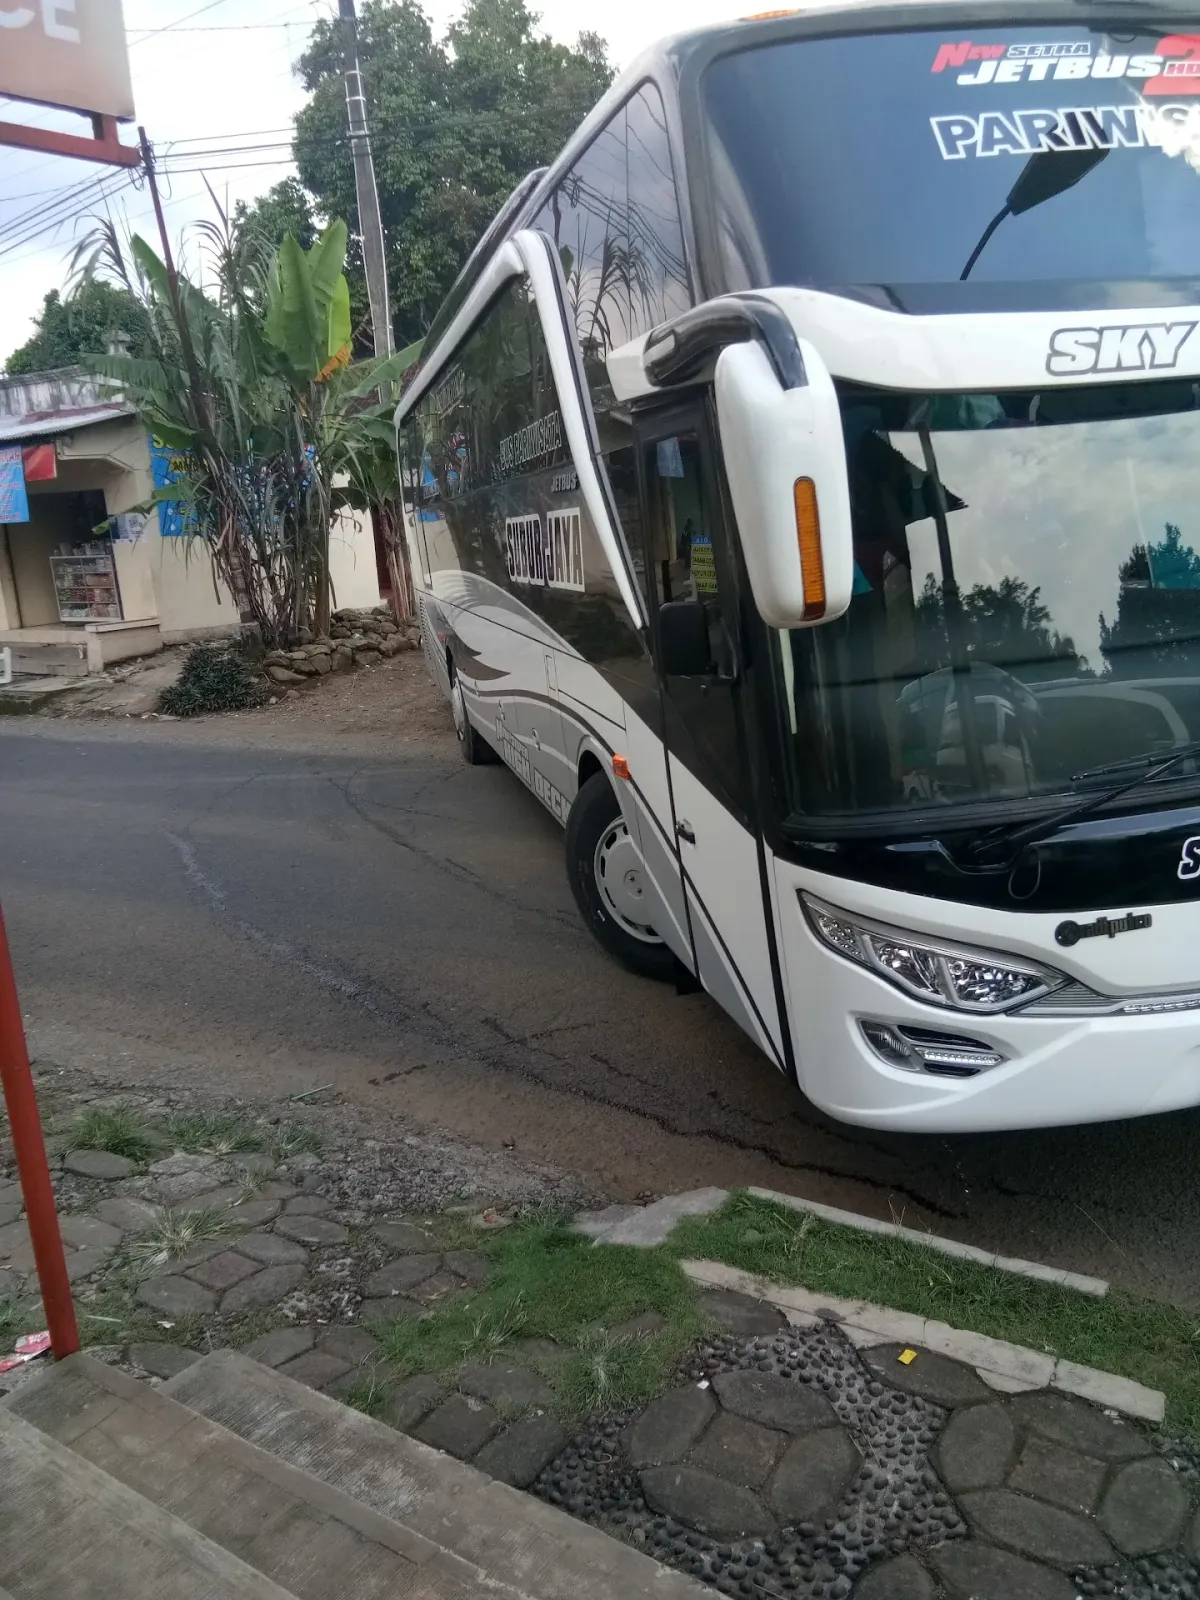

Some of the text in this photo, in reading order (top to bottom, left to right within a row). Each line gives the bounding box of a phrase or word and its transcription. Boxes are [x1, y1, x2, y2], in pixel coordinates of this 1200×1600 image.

[1007, 42, 1091, 58] SETRA
[956, 55, 1164, 86] JETBUS
[1045, 320, 1200, 377] SKY
[551, 472, 577, 492] JETBUS
[505, 507, 585, 592] SUBUR JAYA
